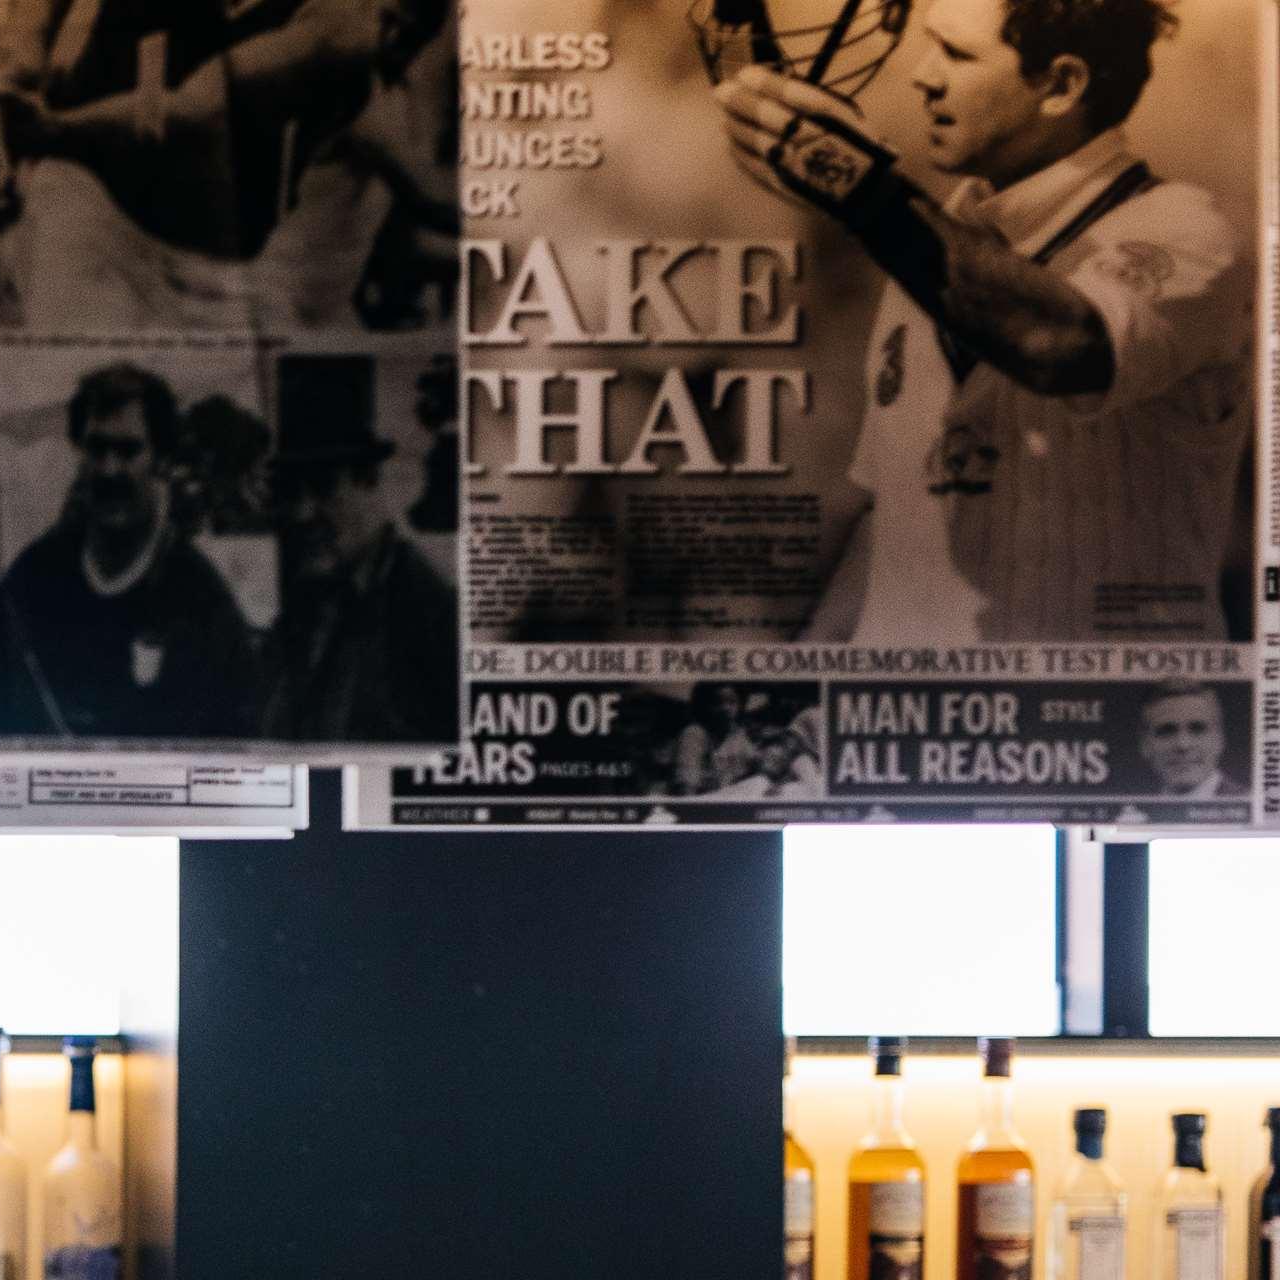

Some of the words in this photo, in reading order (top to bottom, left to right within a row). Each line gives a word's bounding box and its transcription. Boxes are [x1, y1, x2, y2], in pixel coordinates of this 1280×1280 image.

[461, 131, 606, 169] UNCES
[460, 238, 805, 347] TAKE
[460, 368, 811, 476] THAT
[524, 650, 651, 675] DOUBLE
[661, 649, 737, 675] PAGE
[745, 648, 1028, 675] COMMEMORATIVE
[1042, 648, 1111, 675] TEST
[1124, 648, 1240, 675] POSTER
[567, 693, 622, 736] OF
[837, 693, 929, 736] MAN
[942, 693, 1020, 736] FOR
[838, 740, 907, 785] ALL
[920, 740, 1110, 785] REASONS
